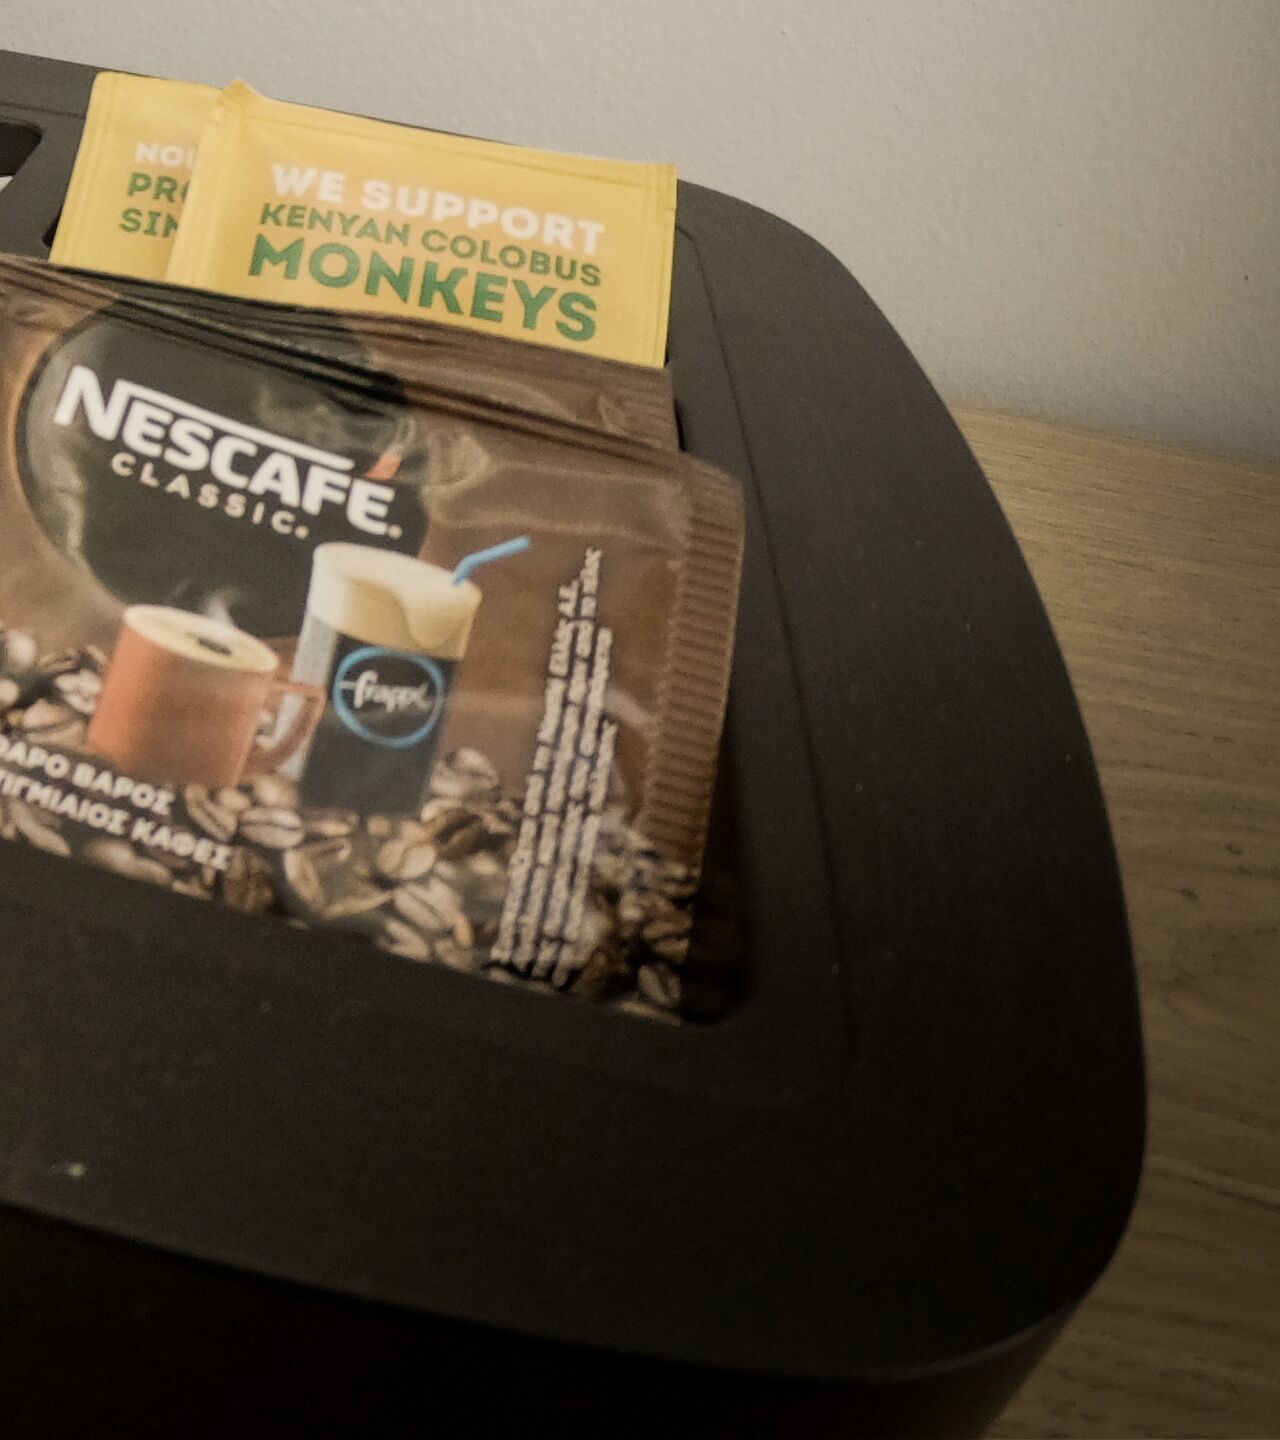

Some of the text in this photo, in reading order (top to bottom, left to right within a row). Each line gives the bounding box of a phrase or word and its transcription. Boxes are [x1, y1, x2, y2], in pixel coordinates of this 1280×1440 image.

[259, 202, 603, 288] KENYAN COLOBUS
[272, 162, 605, 255] WE SUPPORT
[248, 232, 598, 342] MONKEYS
